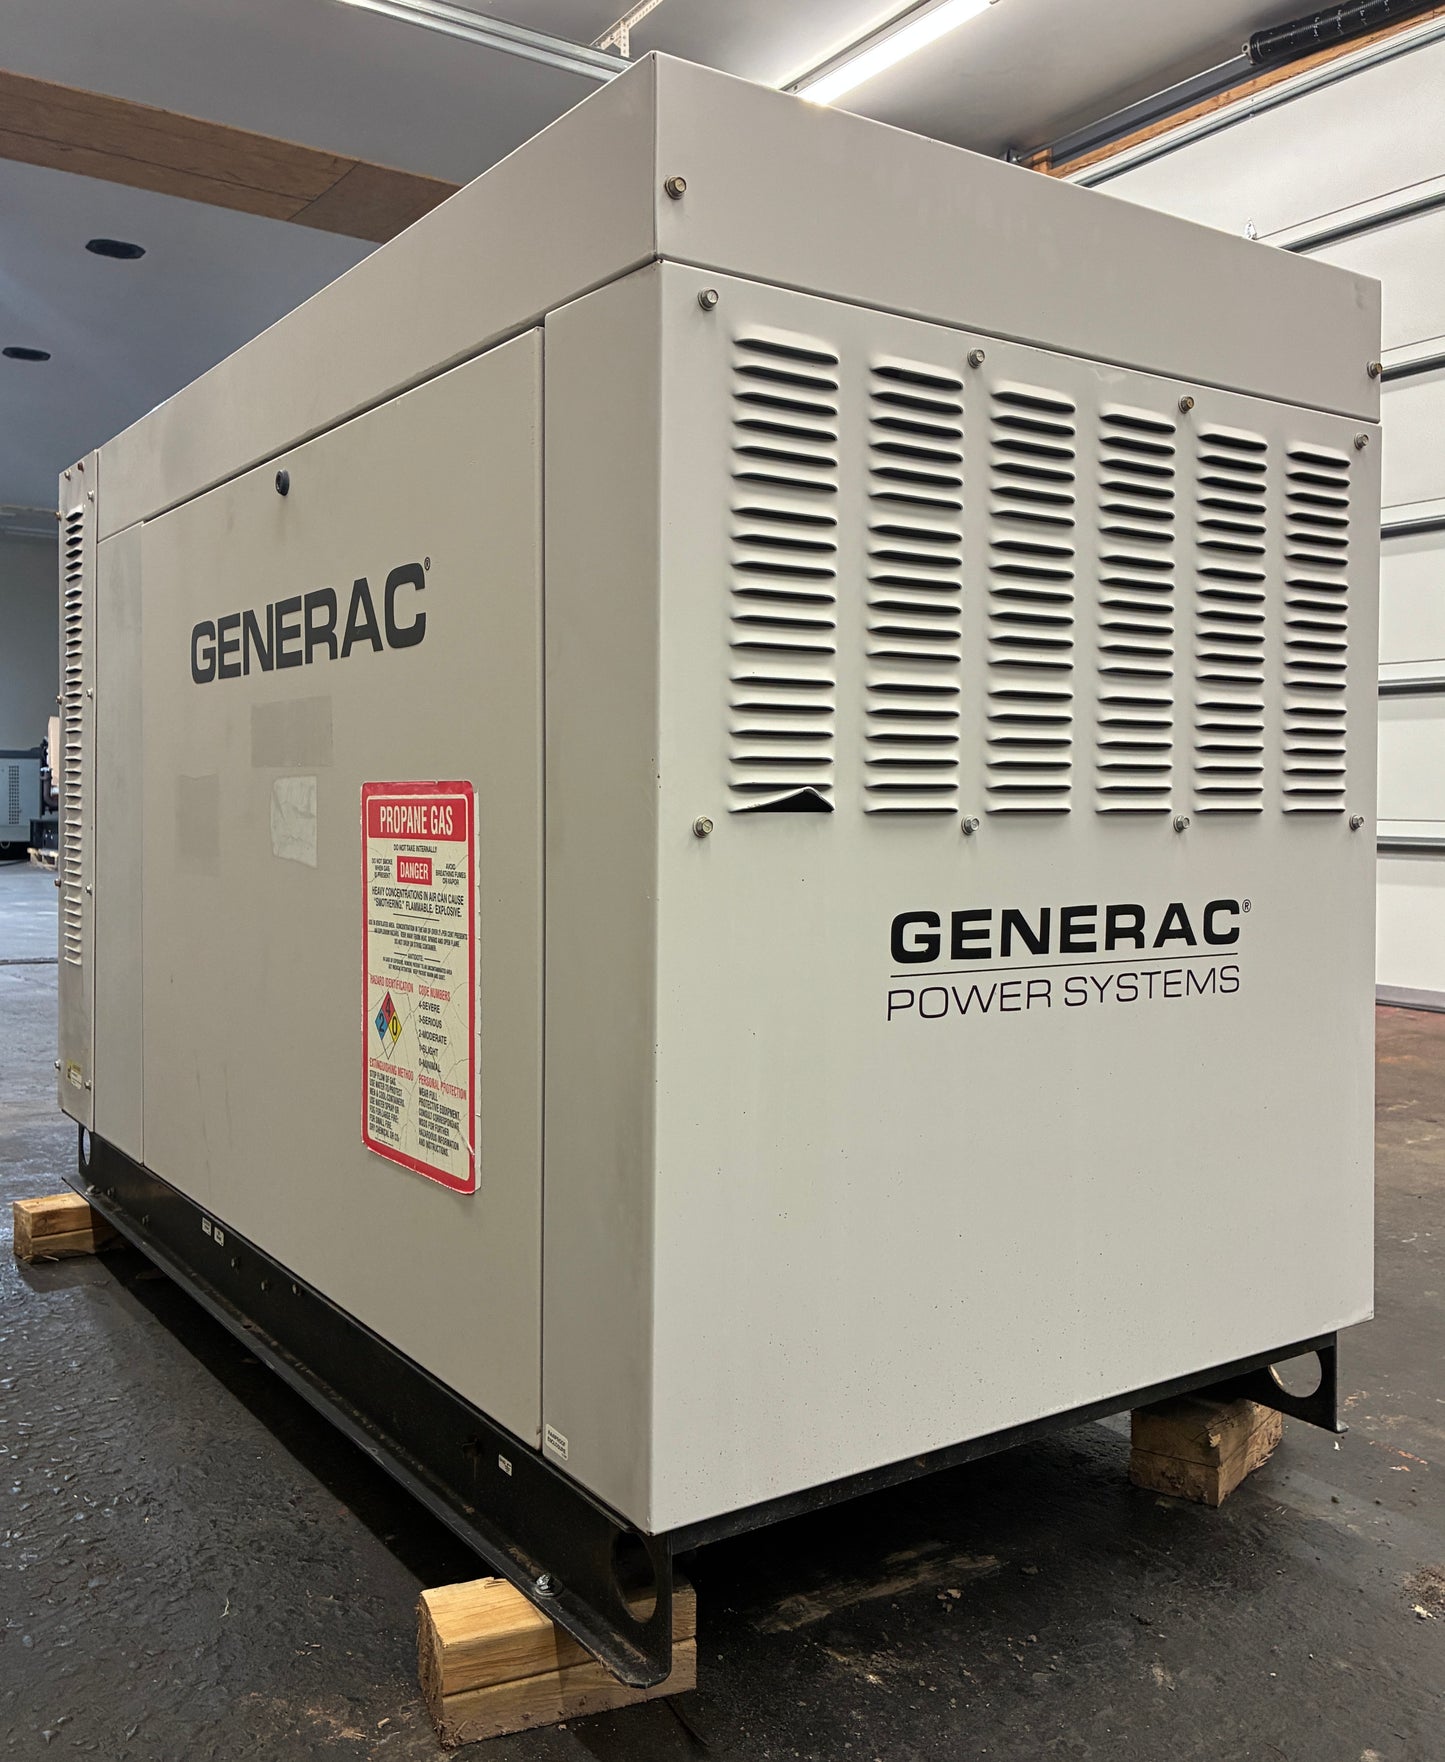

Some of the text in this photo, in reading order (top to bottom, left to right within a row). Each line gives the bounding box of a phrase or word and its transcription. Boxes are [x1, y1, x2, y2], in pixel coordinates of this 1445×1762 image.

[380, 805, 453, 835] PROPANE GAS
[400, 862, 428, 880] DANGER
[372, 887, 385, 896] HEAVY
[386, 888, 422, 900] CONCENTRATIONS
[423, 891, 428, 900] IN
[437, 893, 447, 903] CAN
[448, 894, 464, 905] CAUSE
[370, 976, 413, 993] HAZARD IDENTIFICATION
[419, 985, 450, 1002] CODE NUMBERS
[887, 965, 1240, 1021] POWER SYSTEMS
[386, 998, 391, 1017] 4
[419, 1001, 440, 1014] 4-SEVERE
[379, 1013, 398, 1036] 2 0
[419, 1015, 442, 1029] 3-SERIOUS
[419, 1029, 447, 1045] 2-MODERATE
[369, 1058, 413, 1081] EXTINGUISHING METHOD
[419, 1058, 441, 1072] 0-MINIMAL
[418, 1074, 466, 1100] PERSONAL PROTECTION
